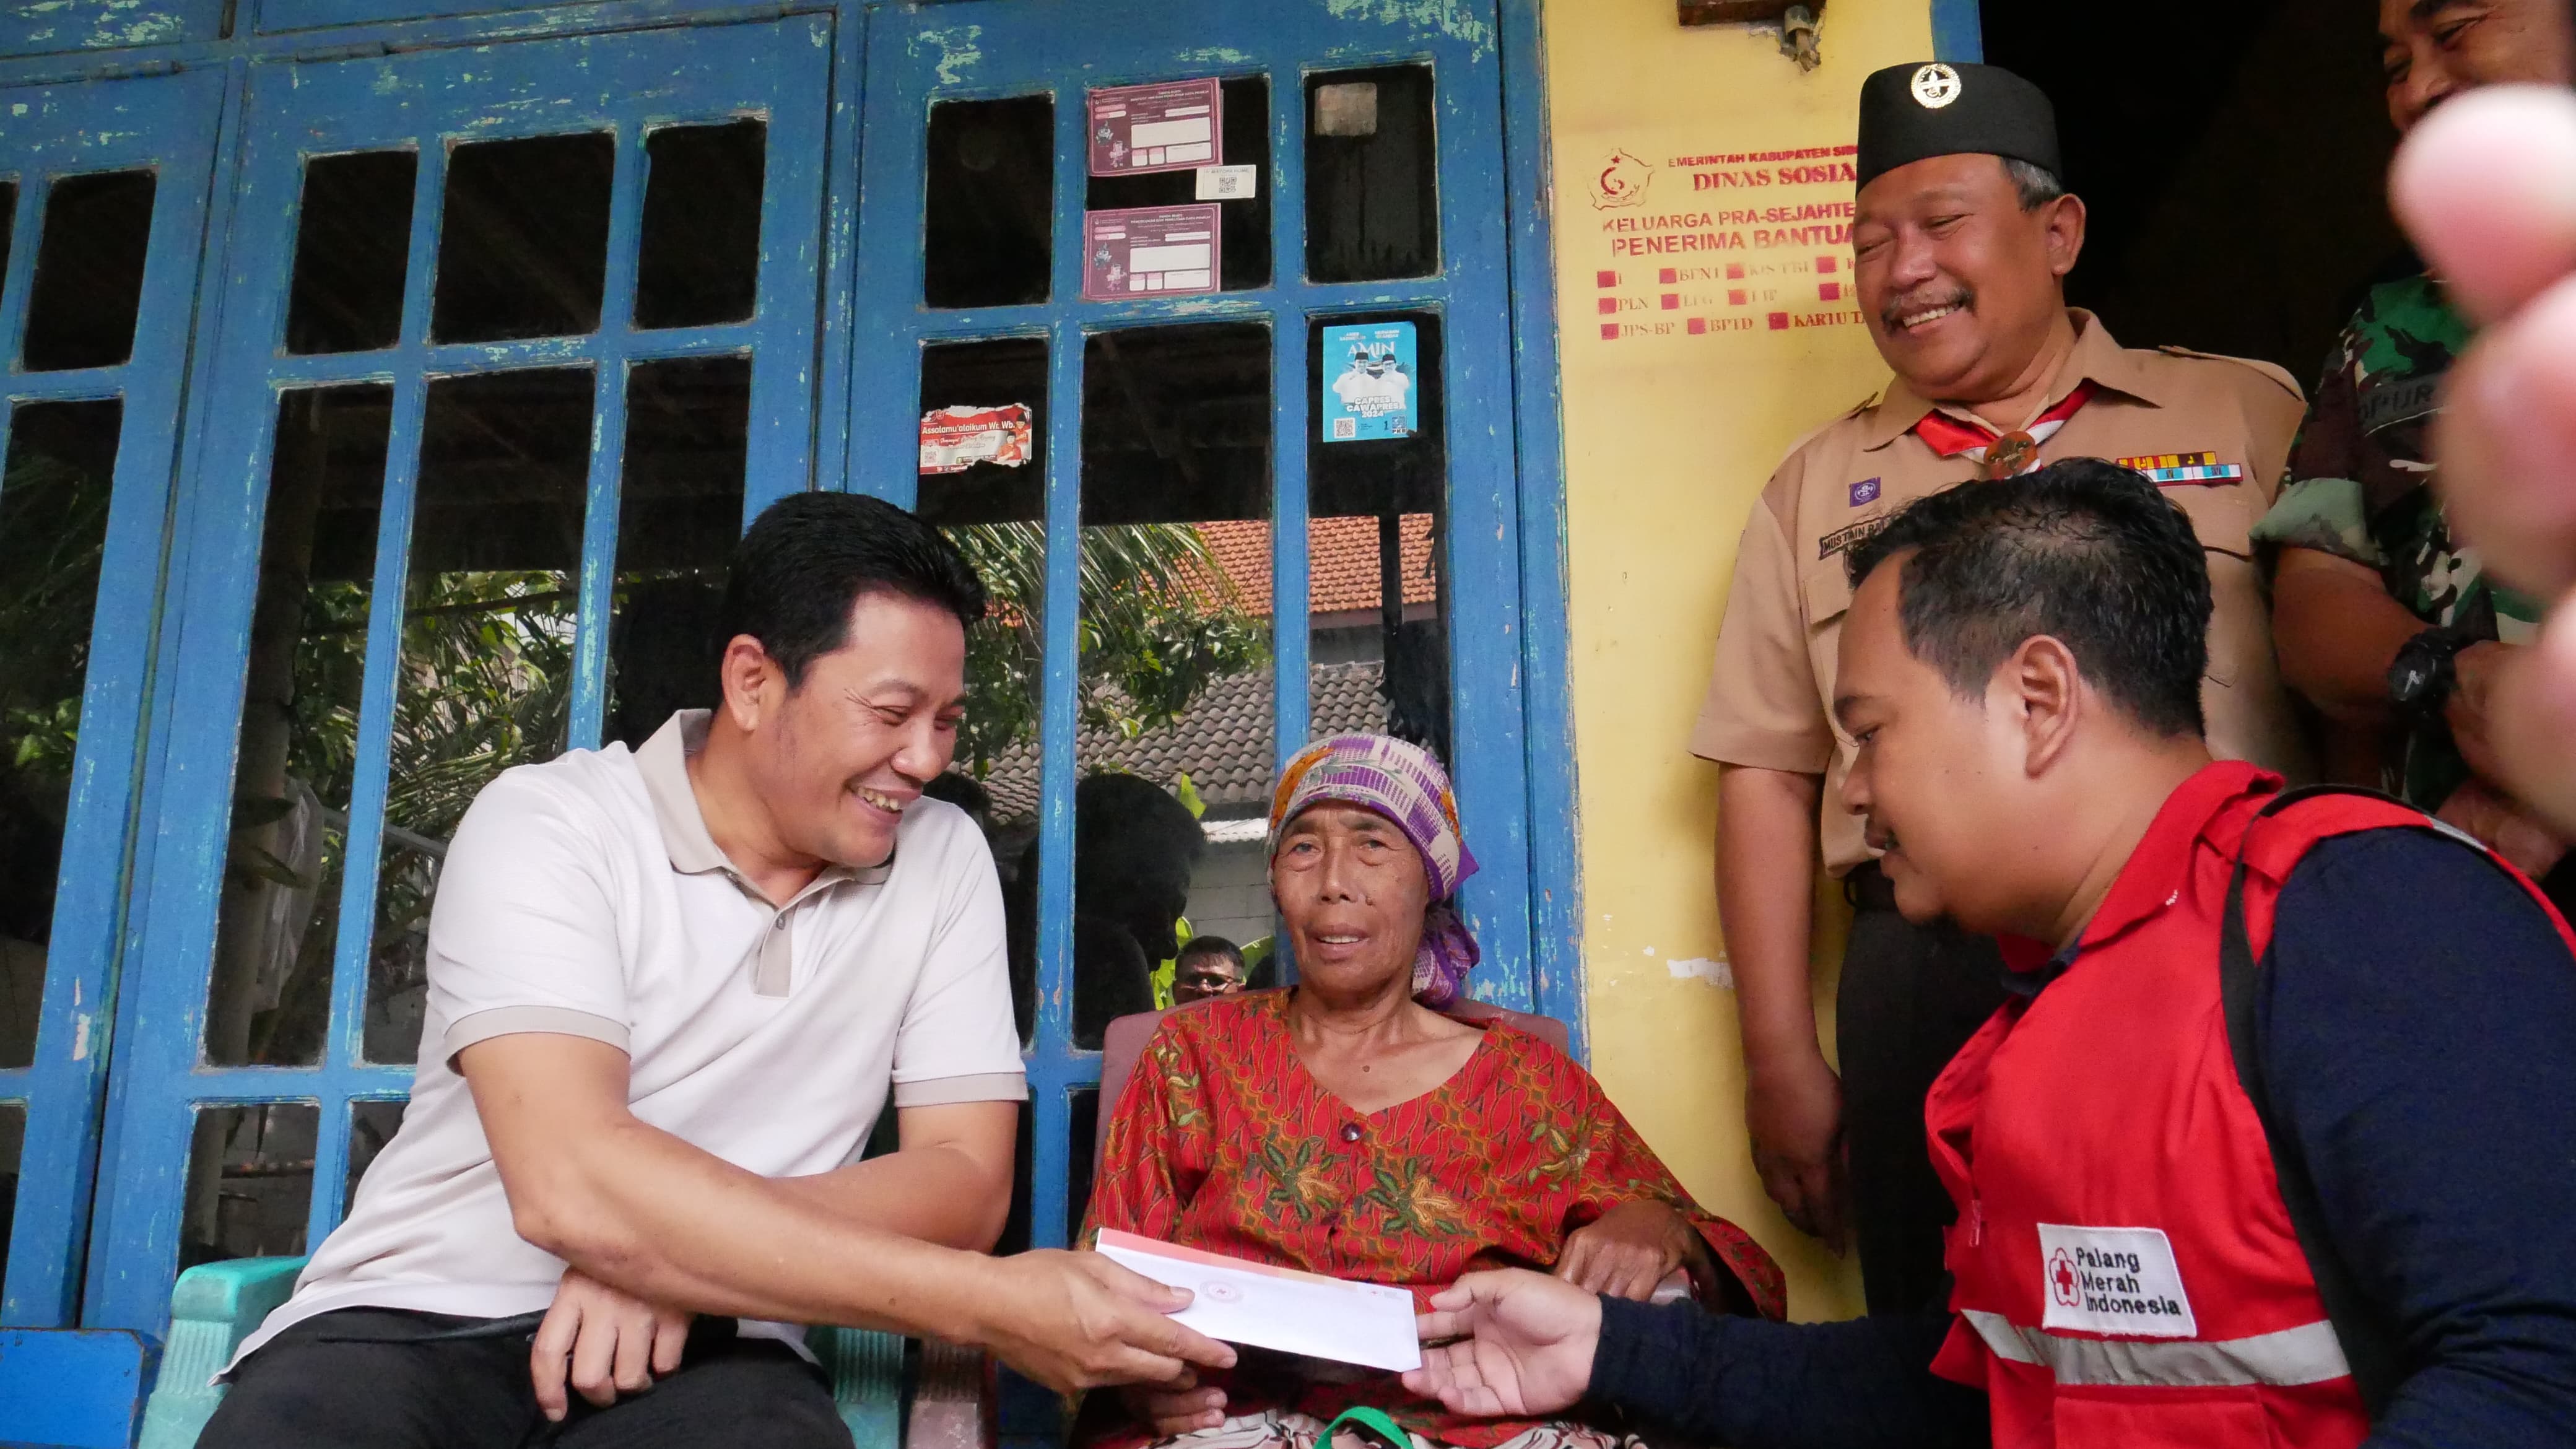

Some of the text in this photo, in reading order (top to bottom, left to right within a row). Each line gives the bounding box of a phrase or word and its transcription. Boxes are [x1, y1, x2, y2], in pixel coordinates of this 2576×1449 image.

[1749, 147, 1831, 162] KABUPATEN
[1693, 162, 1857, 191] DINAS SOSIA
[1603, 202, 1855, 233] KELUARGA PRA-SEJAHTE
[1611, 222, 1855, 257] PENERIMA BANTUA
[1618, 297, 1649, 311] PLN
[1347, 341, 1395, 359] AMIN
[1354, 396, 1391, 405] CAPRES
[1361, 410, 1385, 418] 2024
[921, 424, 987, 435] Assalamu'alaikum
[1001, 421, 1016, 429] Wb.
[1823, 526, 1865, 553] MUSTAIN
[2076, 1247, 2141, 1273] Palang
[2080, 1270, 2141, 1294] Merah
[2084, 1292, 2182, 1316] Indonesia
